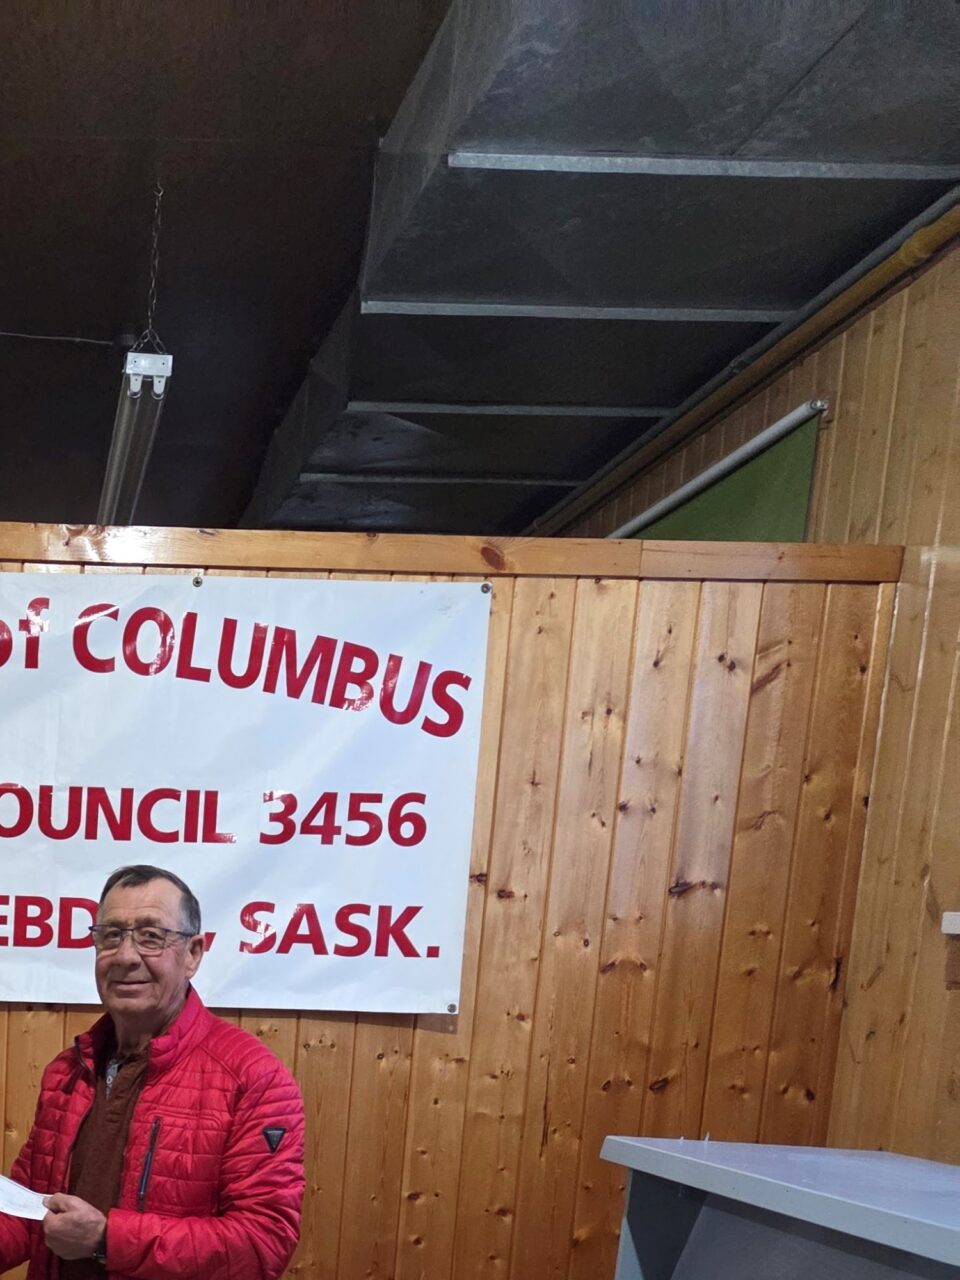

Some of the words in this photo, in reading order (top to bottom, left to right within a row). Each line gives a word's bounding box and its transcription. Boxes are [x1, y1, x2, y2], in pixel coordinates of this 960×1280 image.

[72, 603, 471, 738] COLUMBUS
[259, 789, 427, 847] 3456
[239, 901, 440, 959] SASK.
